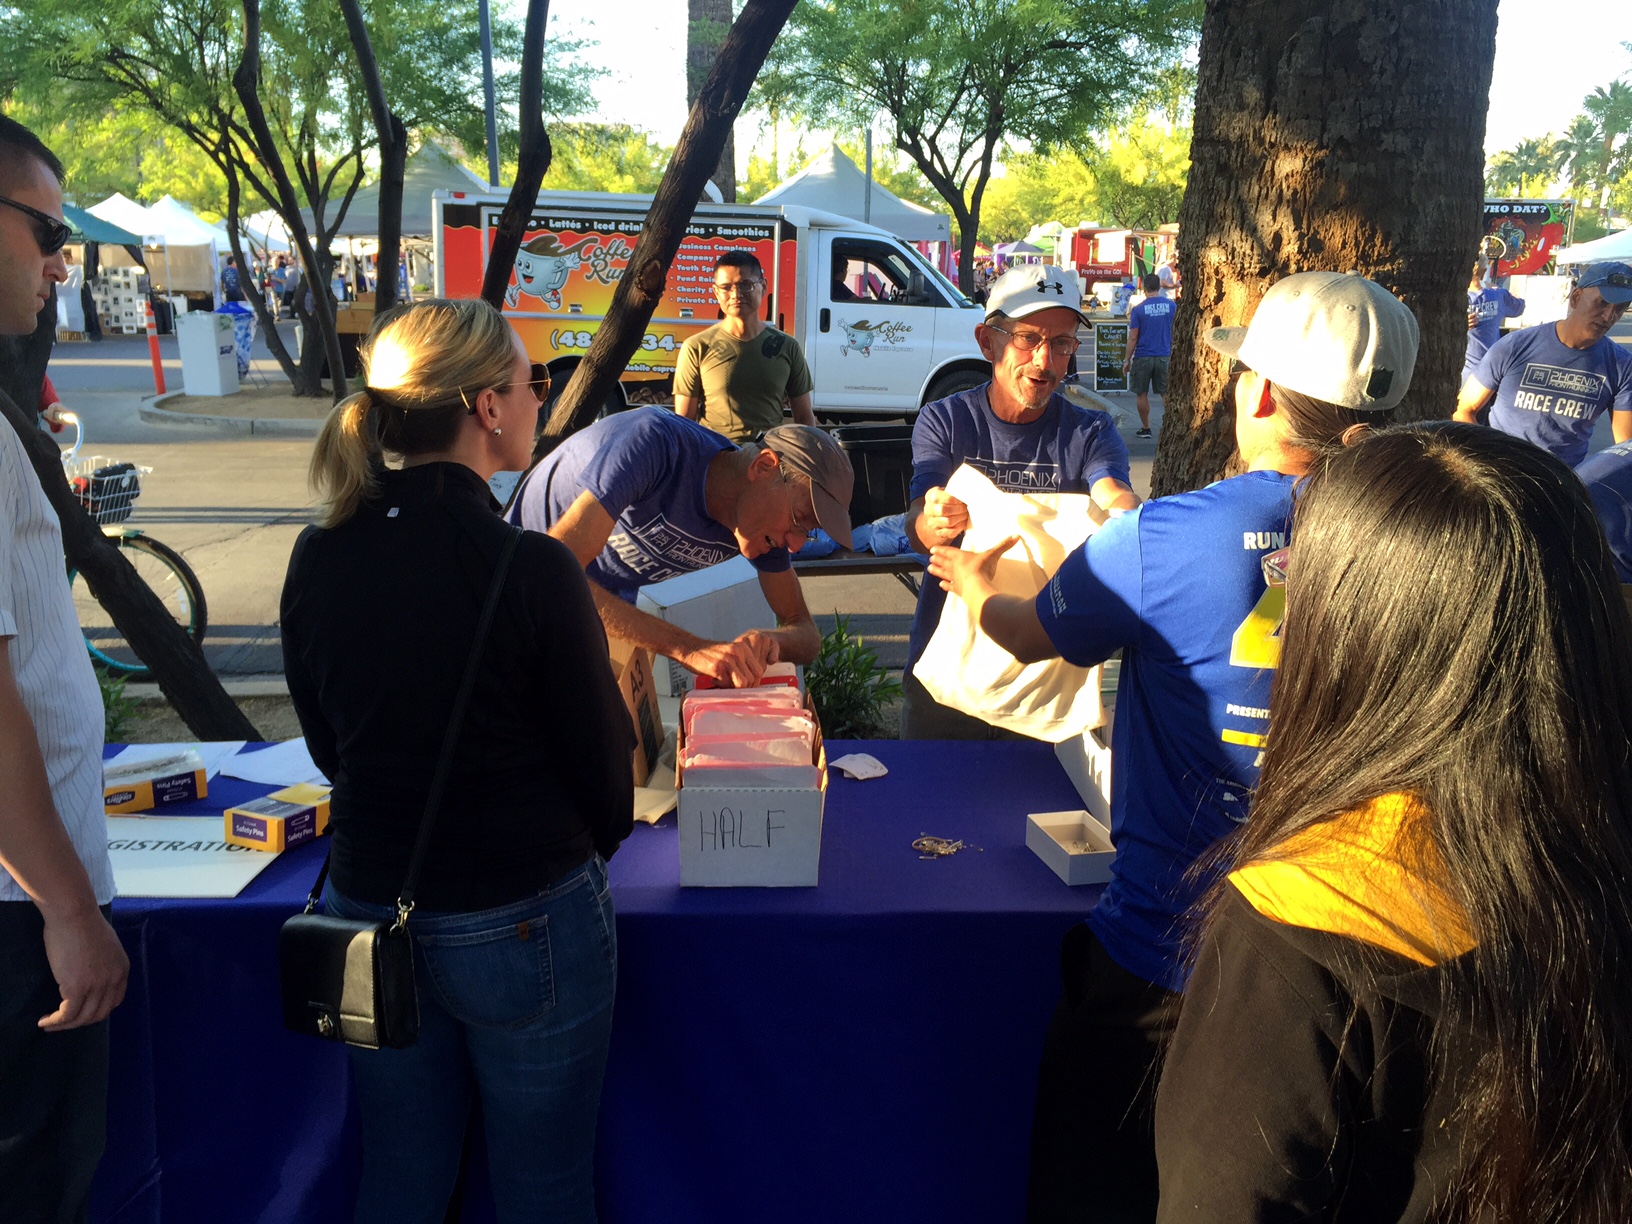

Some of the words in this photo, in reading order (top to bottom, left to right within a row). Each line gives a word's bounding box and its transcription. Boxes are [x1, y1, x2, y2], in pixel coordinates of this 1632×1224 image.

[1512, 205, 1547, 213] DAT?
[549, 219, 582, 229] Lattés
[593, 221, 615, 231] Iced
[618, 222, 644, 232] drin
[685, 225, 705, 234] ries
[716, 226, 770, 237] Smoothies
[578, 236, 631, 262] Coffe
[714, 244, 756, 252] Complexes
[677, 254, 714, 262] Company
[676, 286, 706, 294] Charity
[879, 321, 913, 334] Coffee
[550, 329, 592, 350] (48
[882, 332, 906, 345] Run
[1550, 371, 1600, 388] PHOENIX
[1514, 390, 1553, 413] RACE
[1554, 398, 1597, 420] CREW
[988, 469, 1057, 488] PHOENIX
[1243, 532, 1285, 550] RUN
[607, 532, 659, 575] RACE
[673, 540, 730, 563] PHOENIX
[630, 658, 644, 702] A3
[1226, 703, 1271, 719] PRESENT
[236, 824, 253, 836] Safety
[253, 826, 264, 837] Pins
[287, 831, 303, 843] Safety
[303, 827, 313, 836] Pins
[700, 806, 786, 851] HALF
[107, 839, 263, 852] GISTRATIO
